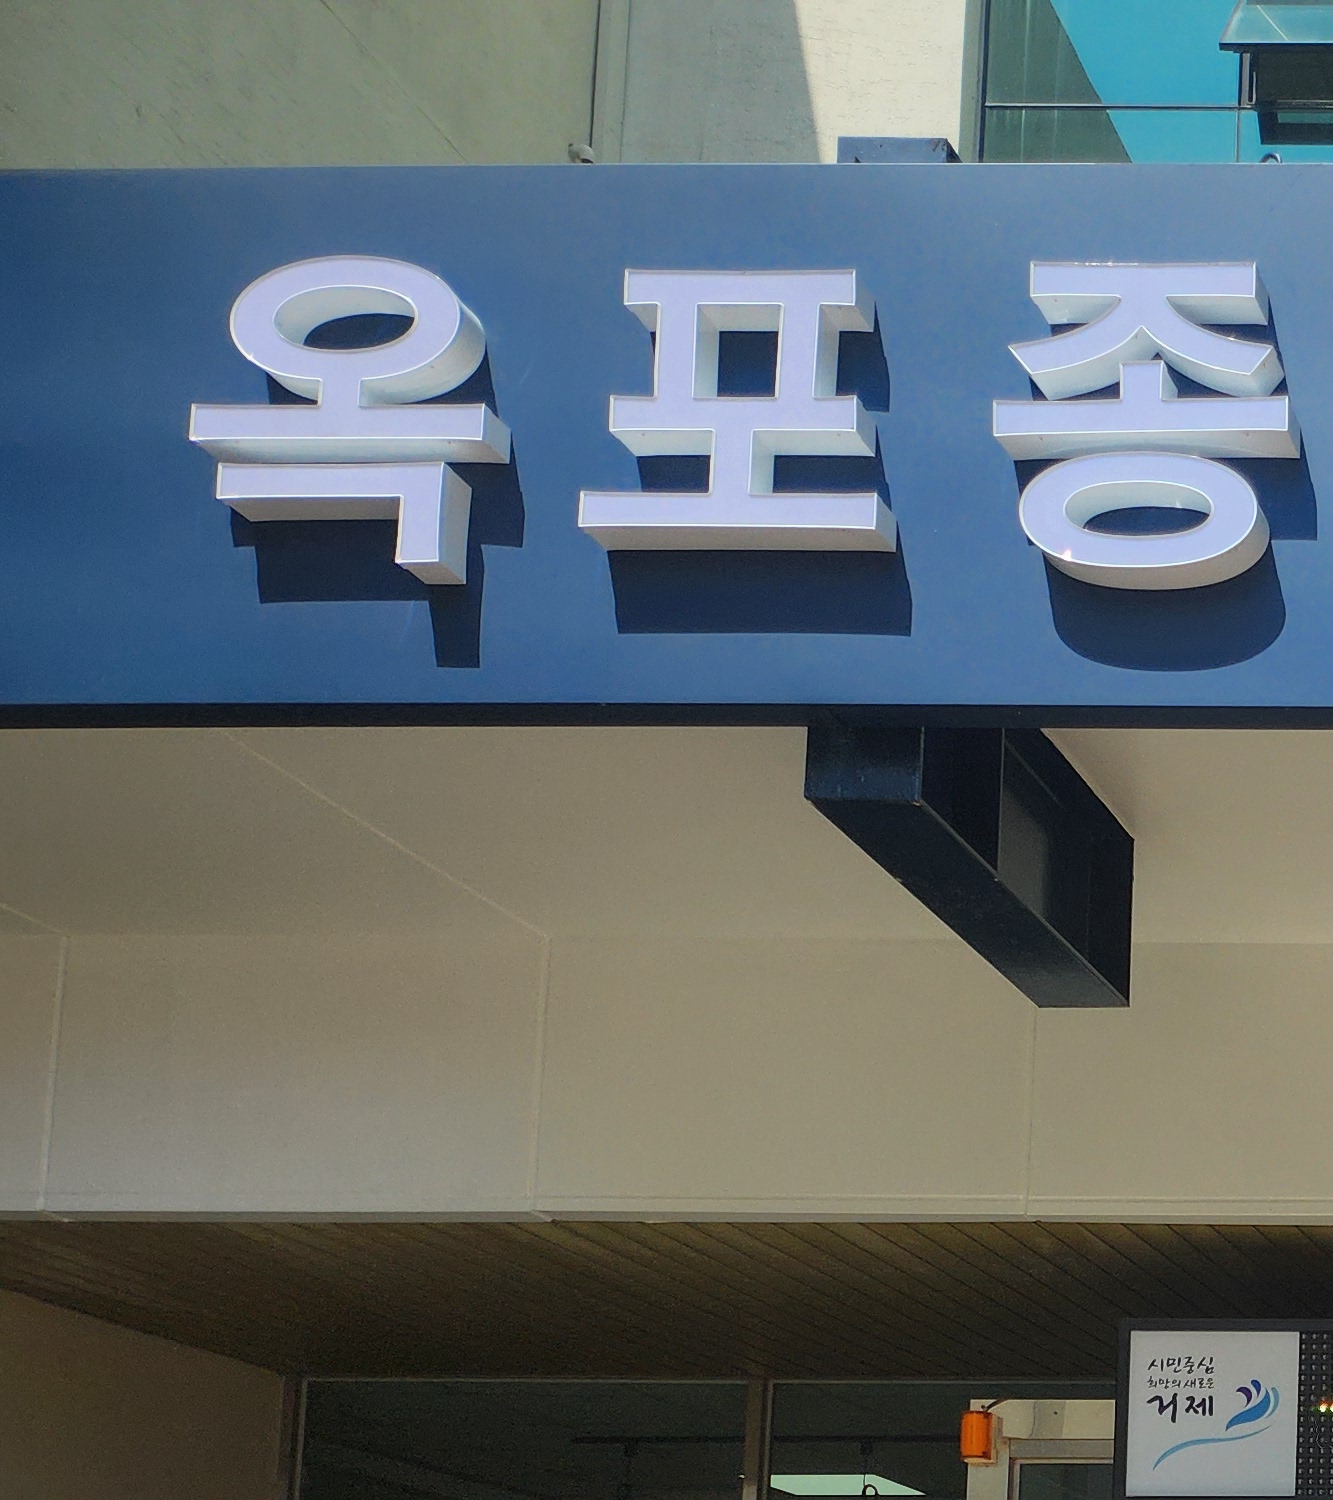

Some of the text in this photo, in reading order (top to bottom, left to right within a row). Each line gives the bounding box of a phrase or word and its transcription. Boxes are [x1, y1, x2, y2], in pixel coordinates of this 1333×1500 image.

[1147, 1355, 1215, 1374] 시민중심
[1146, 1377, 1215, 1389] 희망의 새로운
[1146, 1392, 1215, 1424] 거제
